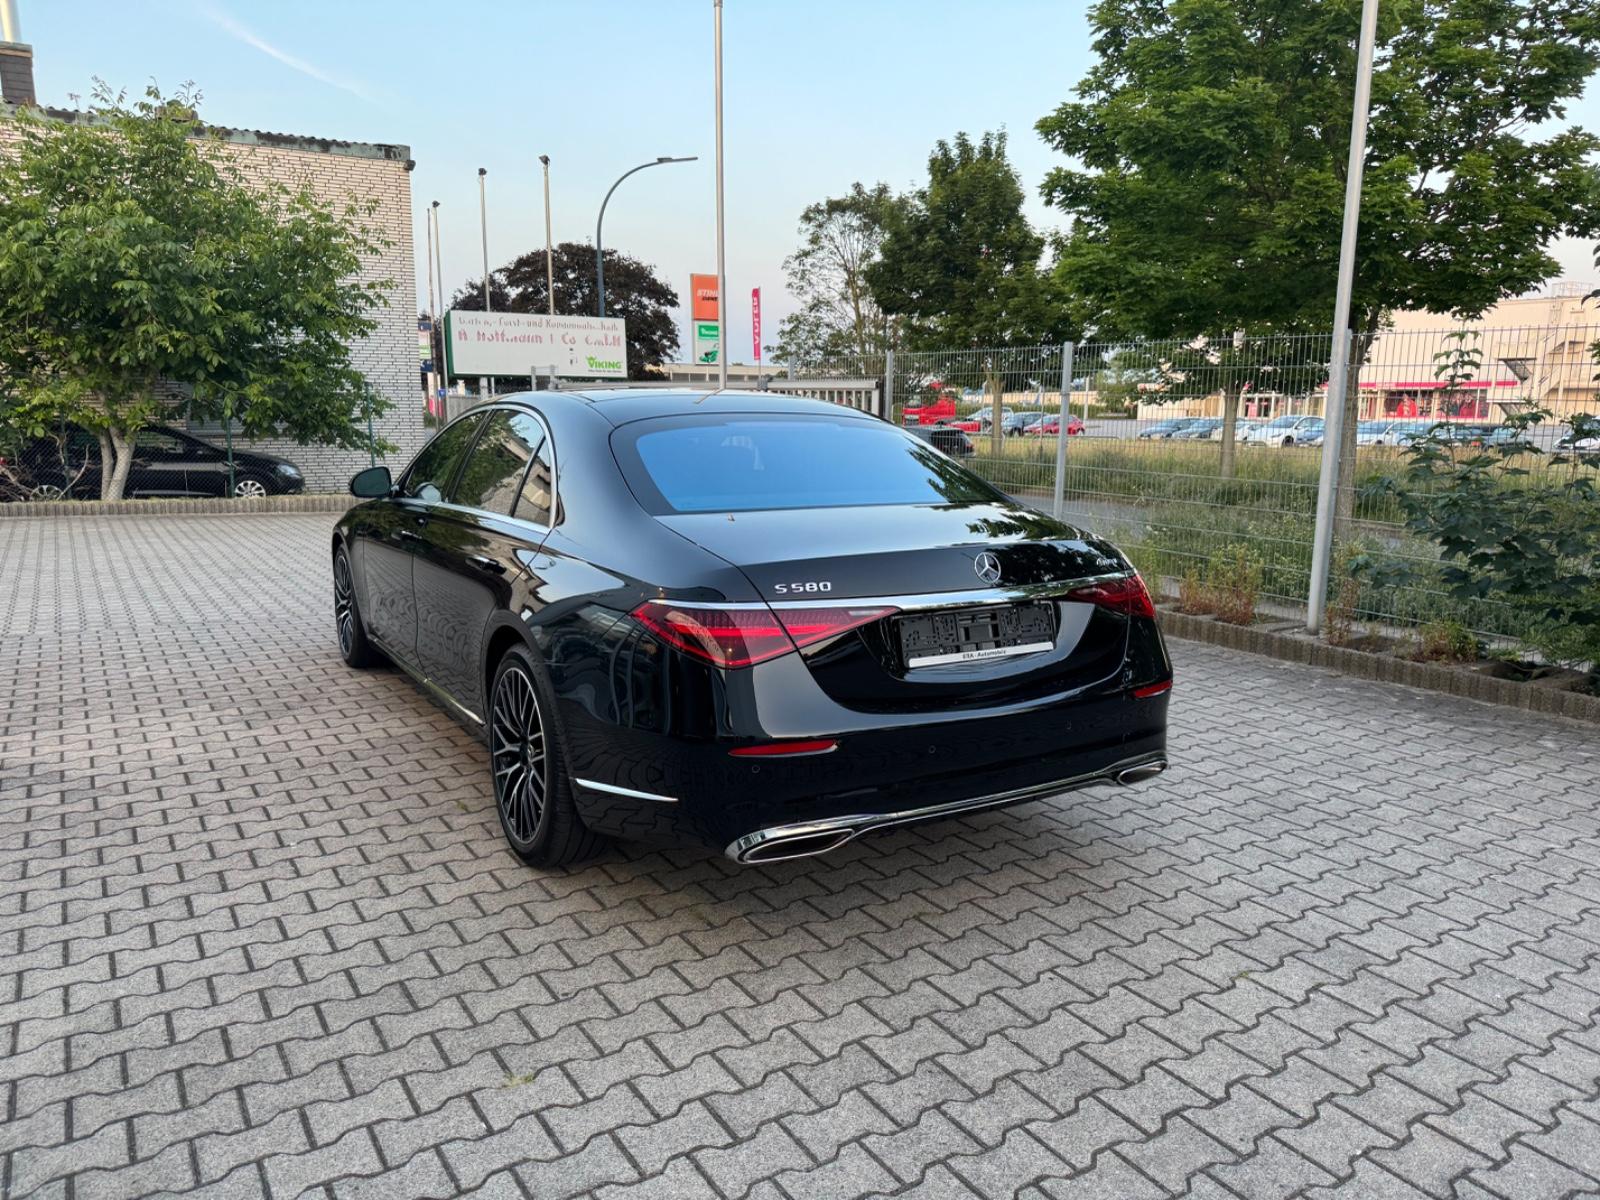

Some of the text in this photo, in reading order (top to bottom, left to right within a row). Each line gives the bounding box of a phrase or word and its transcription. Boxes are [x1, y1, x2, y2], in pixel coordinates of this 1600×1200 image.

[586, 356, 622, 369] VIKING
[774, 581, 832, 594] S 580
